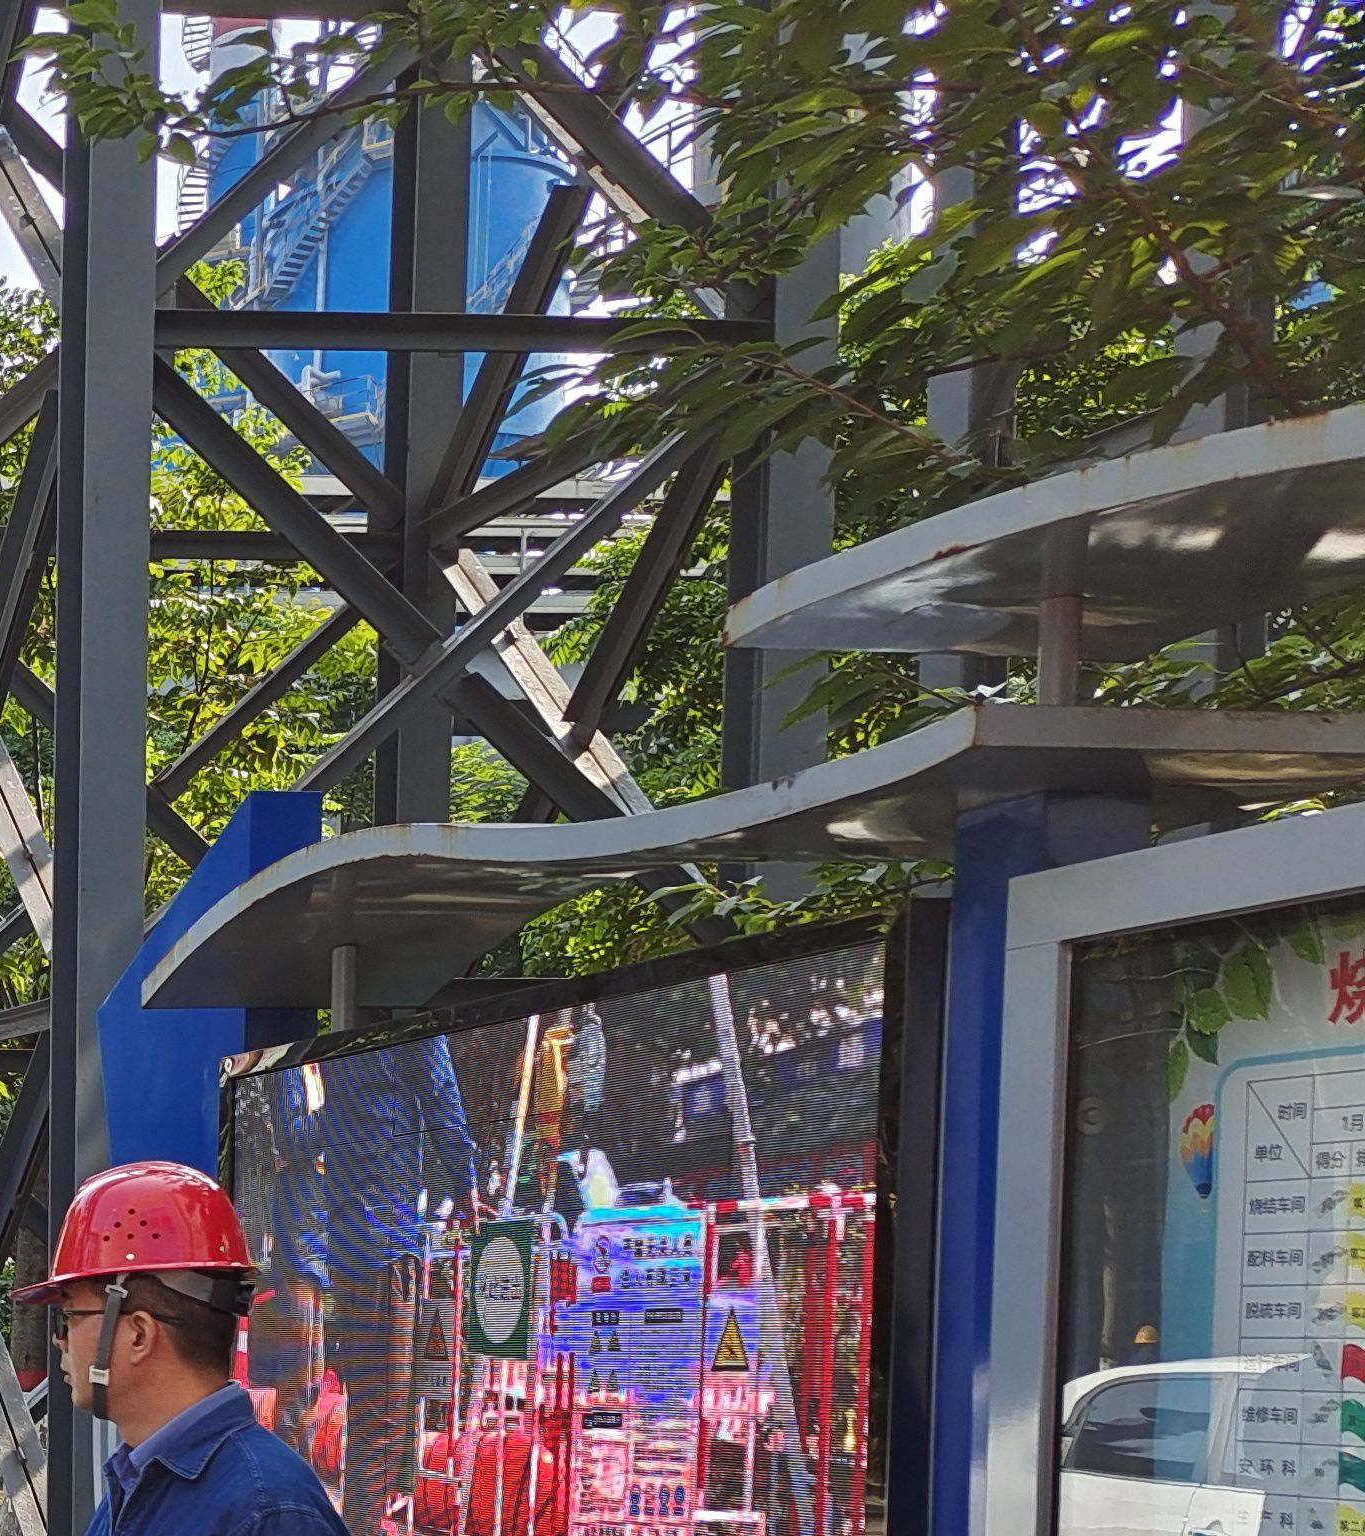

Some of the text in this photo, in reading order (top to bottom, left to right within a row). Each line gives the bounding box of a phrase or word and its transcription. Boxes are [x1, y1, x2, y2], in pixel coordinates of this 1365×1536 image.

[1278, 1102, 1308, 1121] 时间
[1254, 1144, 1283, 1162] 单位
[1315, 1151, 1346, 1170] 得分
[1249, 1196, 1305, 1215] 烧结车间
[1247, 1249, 1303, 1268] 配料车间
[1245, 1302, 1302, 1320] 脱硫车间
[1242, 1407, 1298, 1425] 维修车间
[1238, 1458, 1296, 1477] 安环科
